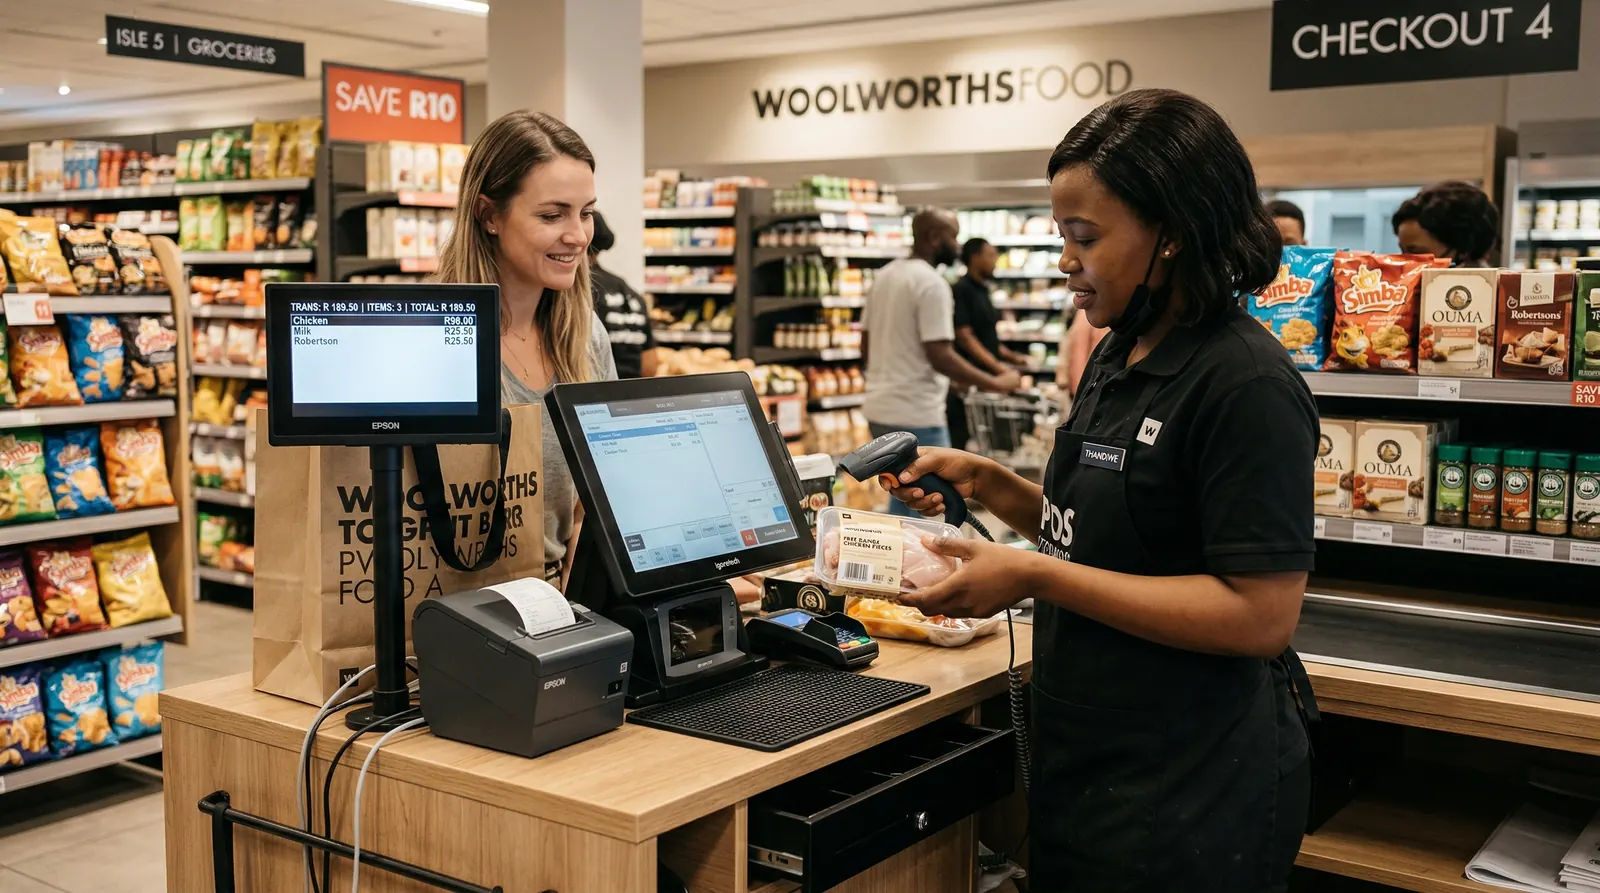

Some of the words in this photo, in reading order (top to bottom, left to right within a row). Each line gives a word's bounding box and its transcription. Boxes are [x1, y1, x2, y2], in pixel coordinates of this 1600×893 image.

[1292, 7, 1513, 59] CHECKOUT
[1525, 2, 1553, 39] 4
[116, 28, 149, 49] ISLE
[153, 33, 165, 50] 5
[187, 37, 277, 65] GROCERIES
[335, 82, 403, 116] SAVE
[409, 90, 457, 122] R10
[1343, 282, 1406, 311] Simba
[291, 303, 321, 312] TRANS:
[323, 303, 330, 312] R
[331, 303, 358, 312] 189.50
[367, 303, 396, 312] ITEMS:
[397, 303, 402, 312] 3
[411, 303, 439, 312] TOTAL:
[441, 303, 448, 312] R
[449, 303, 476, 312] 189.50
[293, 316, 328, 325] Chicken
[444, 316, 473, 326] R98.00
[1432, 310, 1483, 323] OUMA
[1511, 310, 1561, 320] Robertsons
[294, 327, 311, 335] Milk
[444, 327, 473, 335] R25.50
[294, 336, 338, 346] Robertson
[444, 337, 473, 345] R25.50
[1576, 385, 1600, 394] SAV
[1576, 395, 1595, 404] R10
[372, 421, 400, 430] EPSON
[1144, 425, 1157, 437] W
[1085, 449, 1119, 464] THANDIWE
[1364, 462, 1412, 476] OUMA
[544, 677, 566, 690] EPSON
